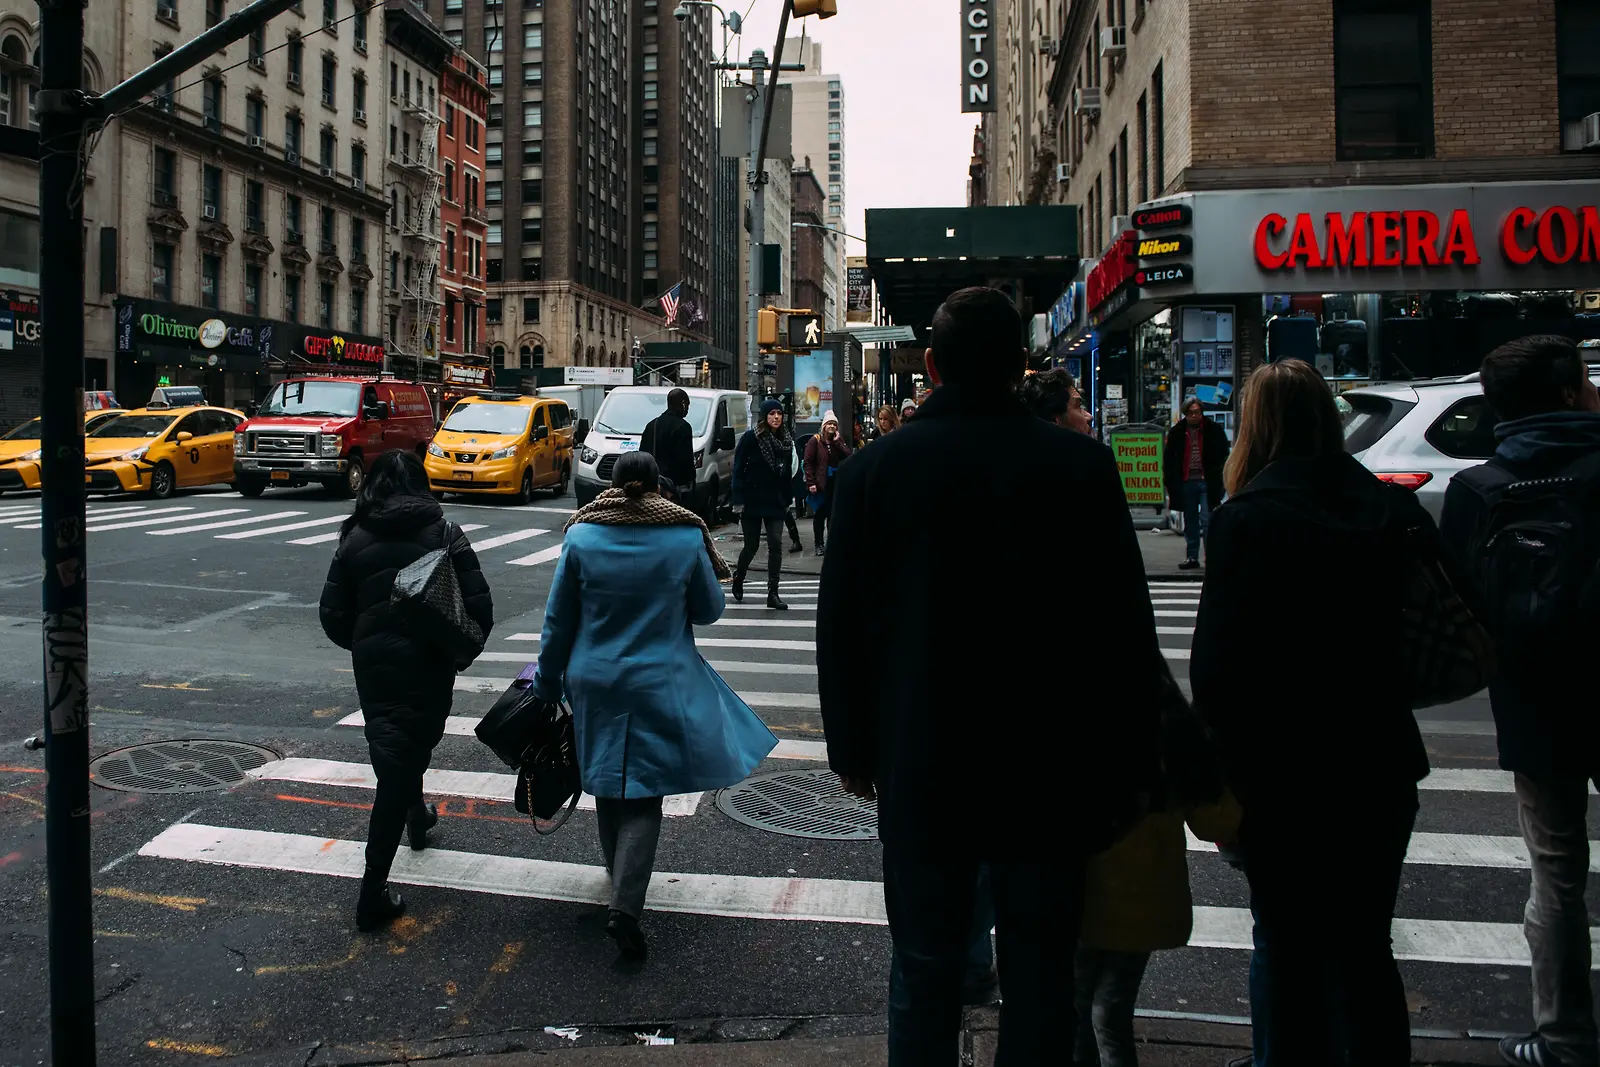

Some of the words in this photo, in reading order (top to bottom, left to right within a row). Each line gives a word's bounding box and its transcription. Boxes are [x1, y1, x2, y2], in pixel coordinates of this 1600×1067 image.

[968, 0, 989, 104] GTON
[1137, 209, 1181, 225] Canon
[1254, 208, 1481, 269] CAMERA
[1138, 239, 1180, 256] Nikon
[1146, 269, 1184, 282] LEICA
[141, 313, 198, 340] Oliviero
[1118, 445, 1157, 458] Prepaid
[1136, 461, 1158, 472] Card
[1125, 477, 1161, 488] UNLOCK
